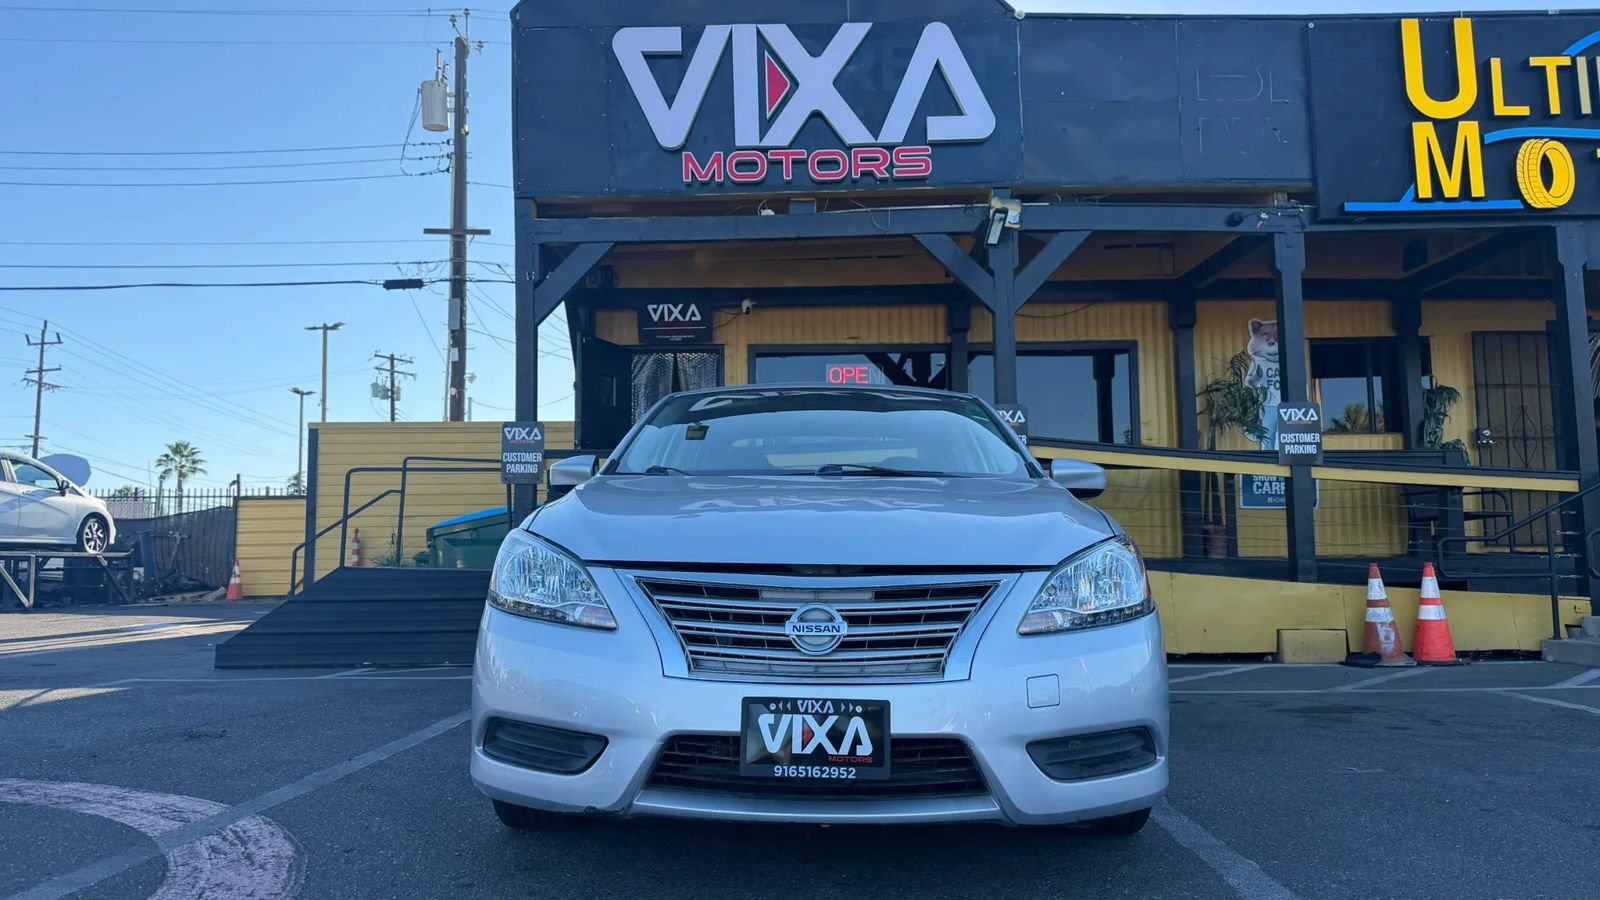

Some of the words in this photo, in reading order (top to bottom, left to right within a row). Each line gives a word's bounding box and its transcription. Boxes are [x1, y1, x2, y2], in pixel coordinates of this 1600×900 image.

[1400, 18, 1600, 119] ULTI
[612, 21, 996, 151] VIXA
[681, 146, 933, 184] MOTORS
[1411, 121, 1600, 209] MO
[647, 303, 702, 322] VIXA
[1266, 367, 1280, 379] CA
[1267, 379, 1281, 390] FO
[1280, 408, 1318, 421] VIXA
[503, 427, 542, 440] VIXA
[1281, 433, 1320, 443] CUSTOMER
[1285, 444, 1317, 455] PARKING
[503, 452, 542, 462] CUSTOMER
[506, 463, 538, 474] PARKING
[1252, 482, 1286, 495] CARF
[792, 625, 840, 633] NISSAN
[797, 700, 835, 714] VIXA
[758, 714, 873, 756] VIXA
[828, 756, 874, 764] MOTORS
[773, 765, 857, 779] 9165162952
